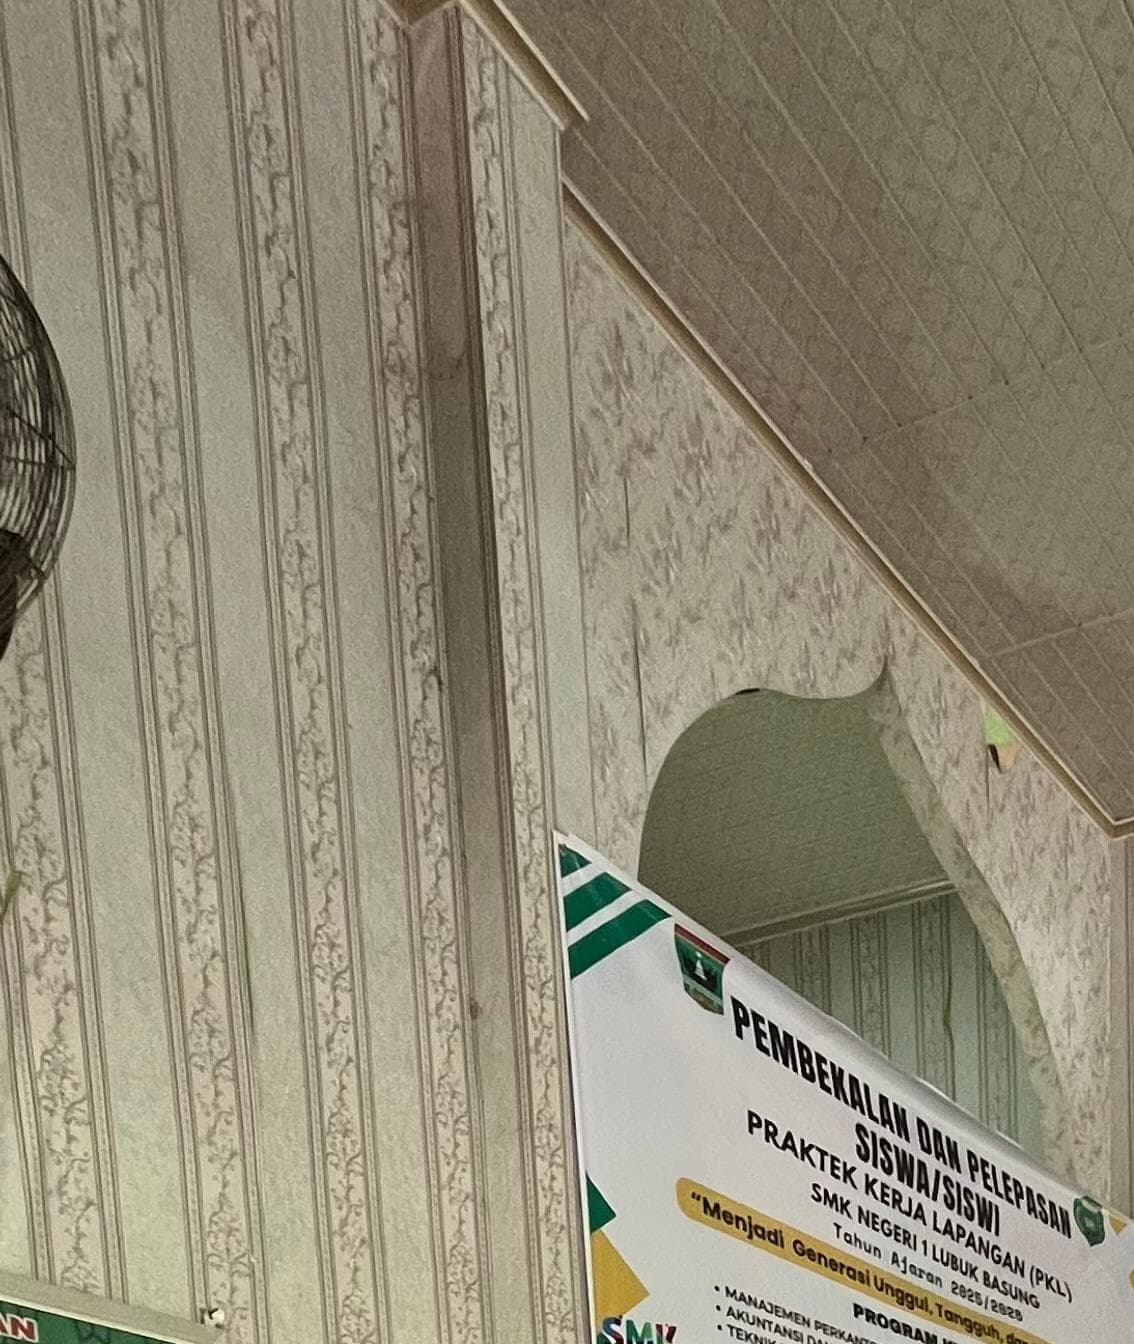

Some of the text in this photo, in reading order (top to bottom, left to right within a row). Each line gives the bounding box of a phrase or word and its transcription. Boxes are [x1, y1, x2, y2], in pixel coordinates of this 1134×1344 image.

[730, 995, 1072, 1239] PEMBEKALAN DAN PELEPASAN
[747, 1109, 1073, 1303] PRAKTEK KERJA LAPANGAN (PKL)
[855, 1122, 1000, 1237] SISWA/SISWI
[792, 1239, 871, 1286] Generasi
[873, 1275, 933, 1315] Unggul,
[935, 1302, 1004, 1344] Tangguh,
[811, 1183, 1041, 1309] SMK NEGERI 1 LUBUK BASUNG
[833, 1222, 882, 1259] Tahun
[891, 1252, 943, 1288] Ajaran
[725, 1286, 811, 1328] MANAJEMEN
[726, 1306, 804, 1344] AKUNTANSI
